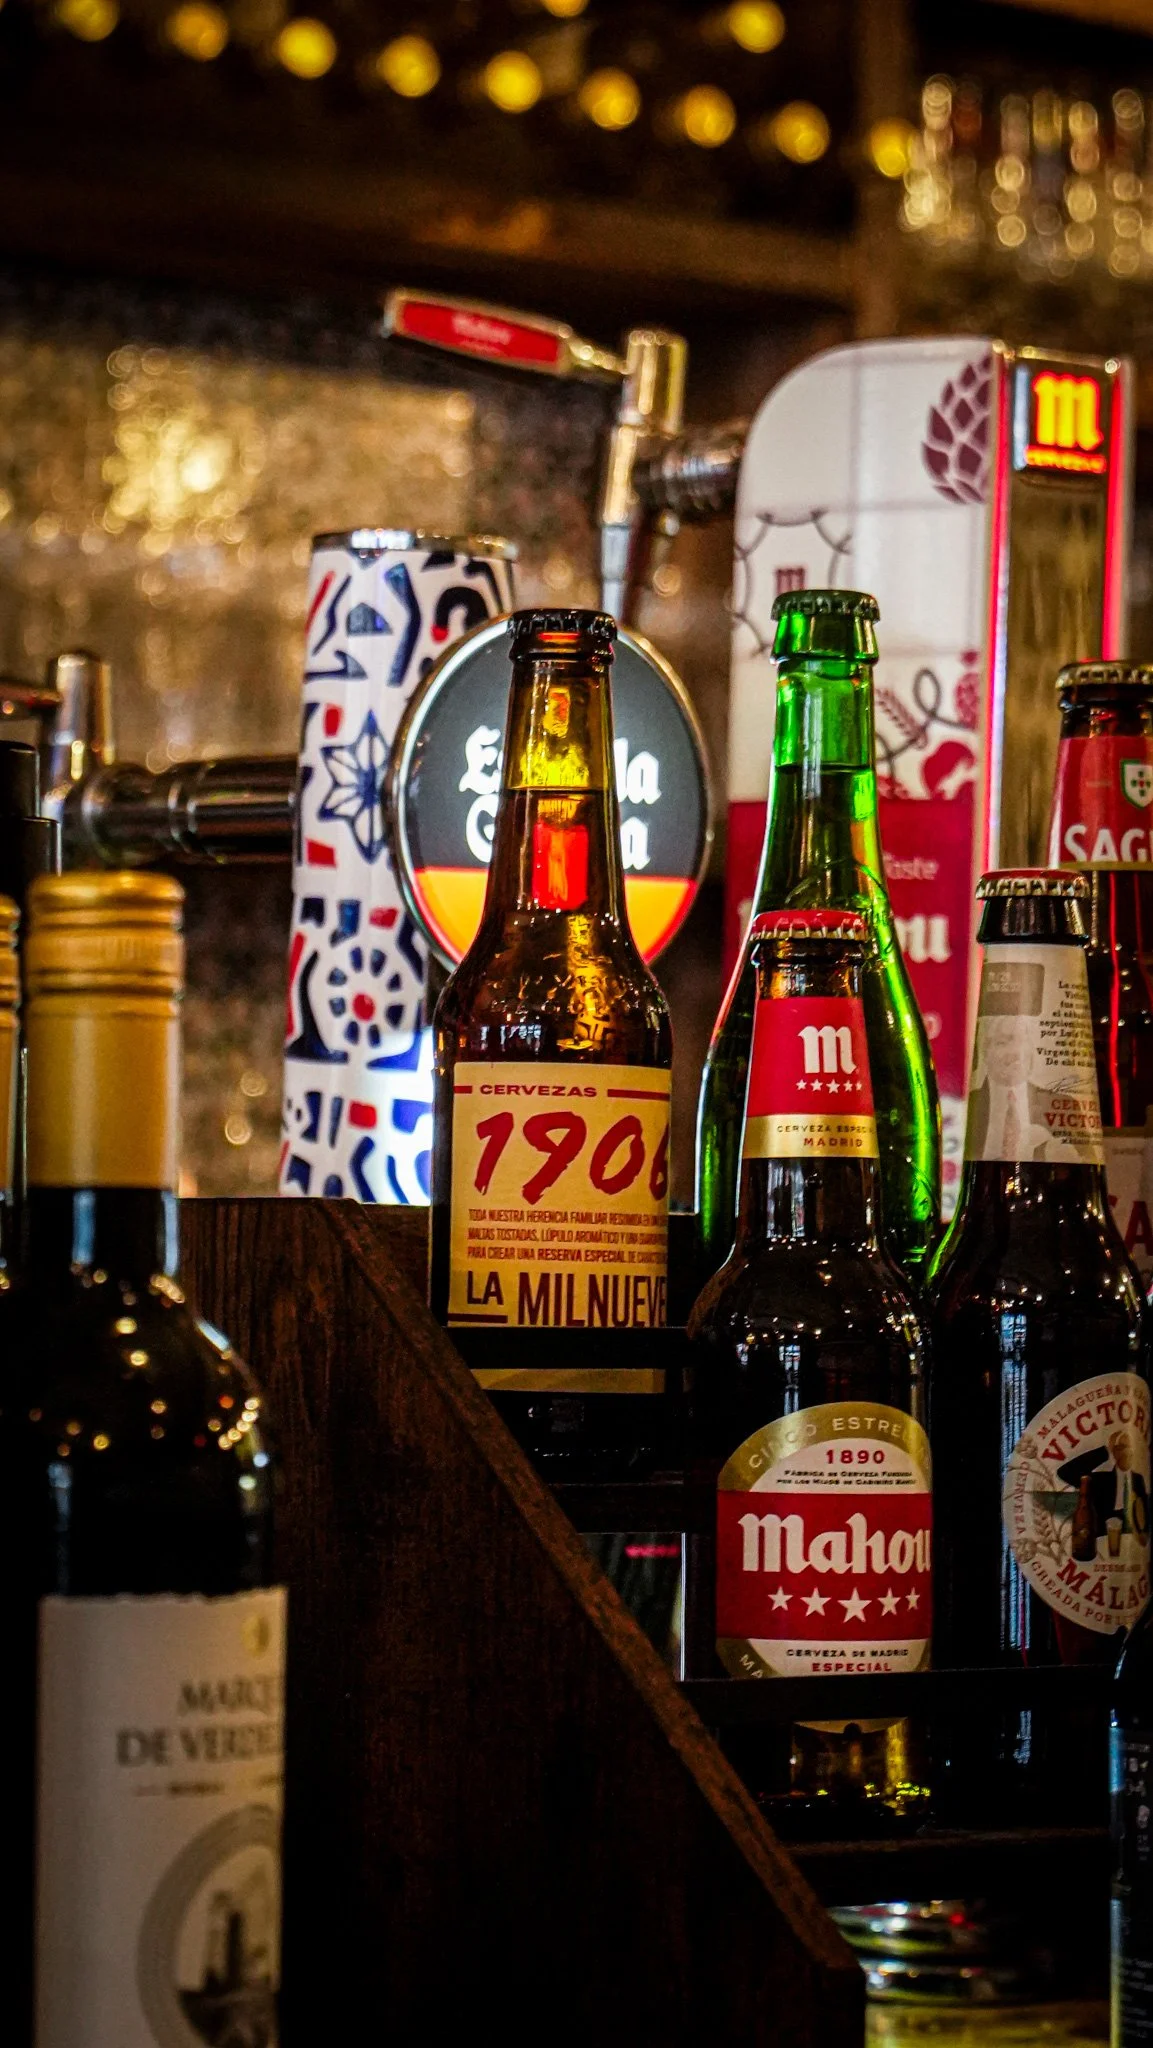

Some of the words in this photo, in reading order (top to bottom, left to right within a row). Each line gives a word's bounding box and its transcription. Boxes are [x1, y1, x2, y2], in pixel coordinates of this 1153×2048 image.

[1064, 823, 1153, 862] SAG
[479, 1084, 597, 1097] CERVEZAS
[777, 1124, 831, 1133] CERVEZA
[1044, 1112, 1102, 1128] VICTOR
[803, 1138, 863, 1148] MADRID
[489, 1209, 524, 1222] NUESTRA
[526, 1211, 568, 1223] HERENCIA
[570, 1211, 607, 1225] FAMILIAR
[467, 1227, 495, 1240] MALTAS
[541, 1228, 573, 1242] LÚPULO
[576, 1230, 618, 1244] AROMÁTICO
[467, 1246, 486, 1259] PARA
[488, 1246, 515, 1260] CREAR
[517, 1247, 534, 1260] UNA
[538, 1248, 581, 1261] RESERVA
[584, 1250, 626, 1263] ESPECIAL
[467, 1271, 504, 1306] LA
[1037, 1383, 1122, 1440] MALAGUEÑA
[832, 1416, 904, 1438] ESTRE
[1041, 1399, 1148, 1462] VICTOR
[826, 1449, 885, 1465] 1890
[738, 1512, 932, 1575] Mahou
[1057, 1558, 1148, 1611] MÁLAG
[786, 1649, 846, 1657] CERVEZA
[870, 1649, 909, 1657] MADRID
[811, 1662, 892, 1672] ESPECIAL
